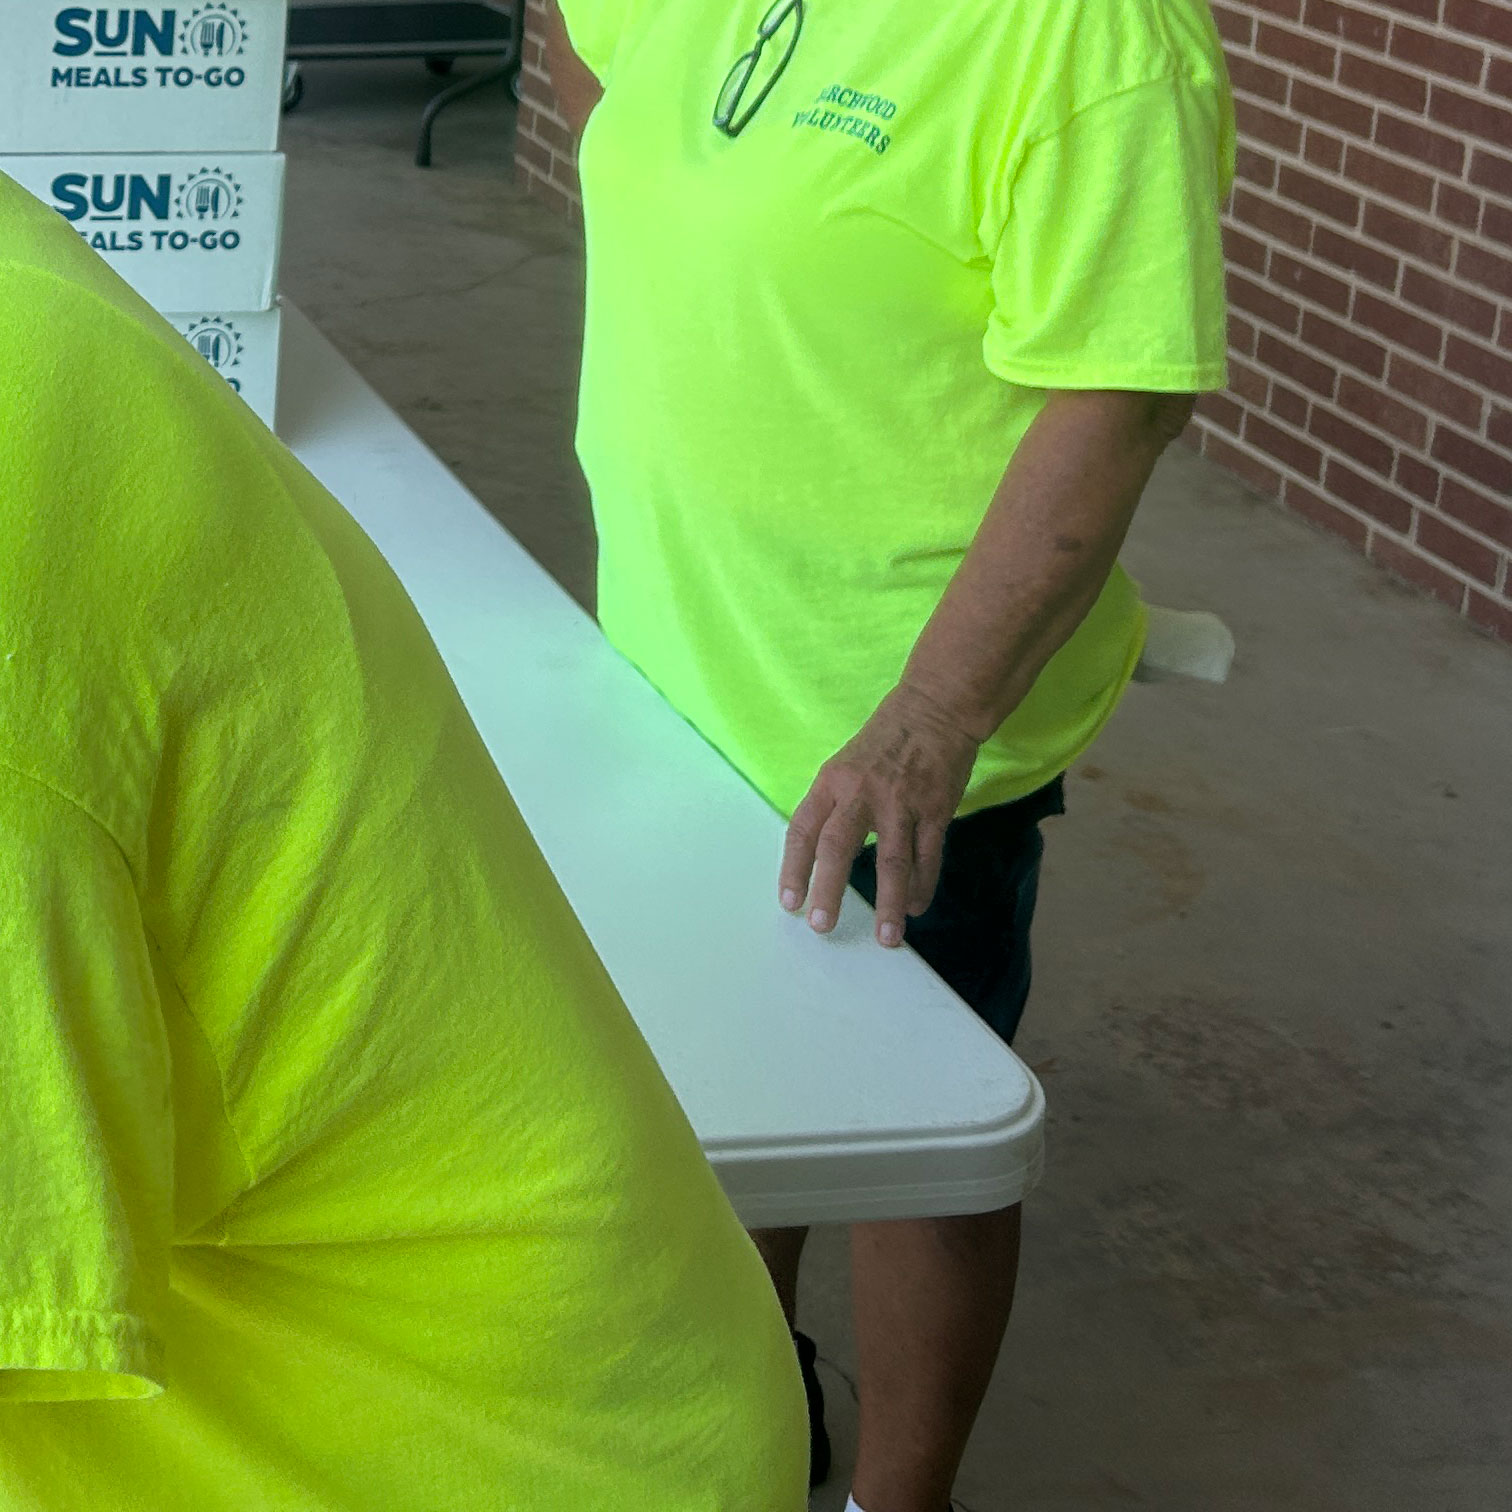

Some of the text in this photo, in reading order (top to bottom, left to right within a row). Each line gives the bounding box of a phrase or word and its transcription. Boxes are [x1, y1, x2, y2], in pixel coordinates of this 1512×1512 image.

[52, 8, 176, 57] SUN
[51, 65, 245, 88] MEALS TO-GO
[51, 173, 171, 221] SUN
[79, 230, 240, 251] ALS TO-GO
